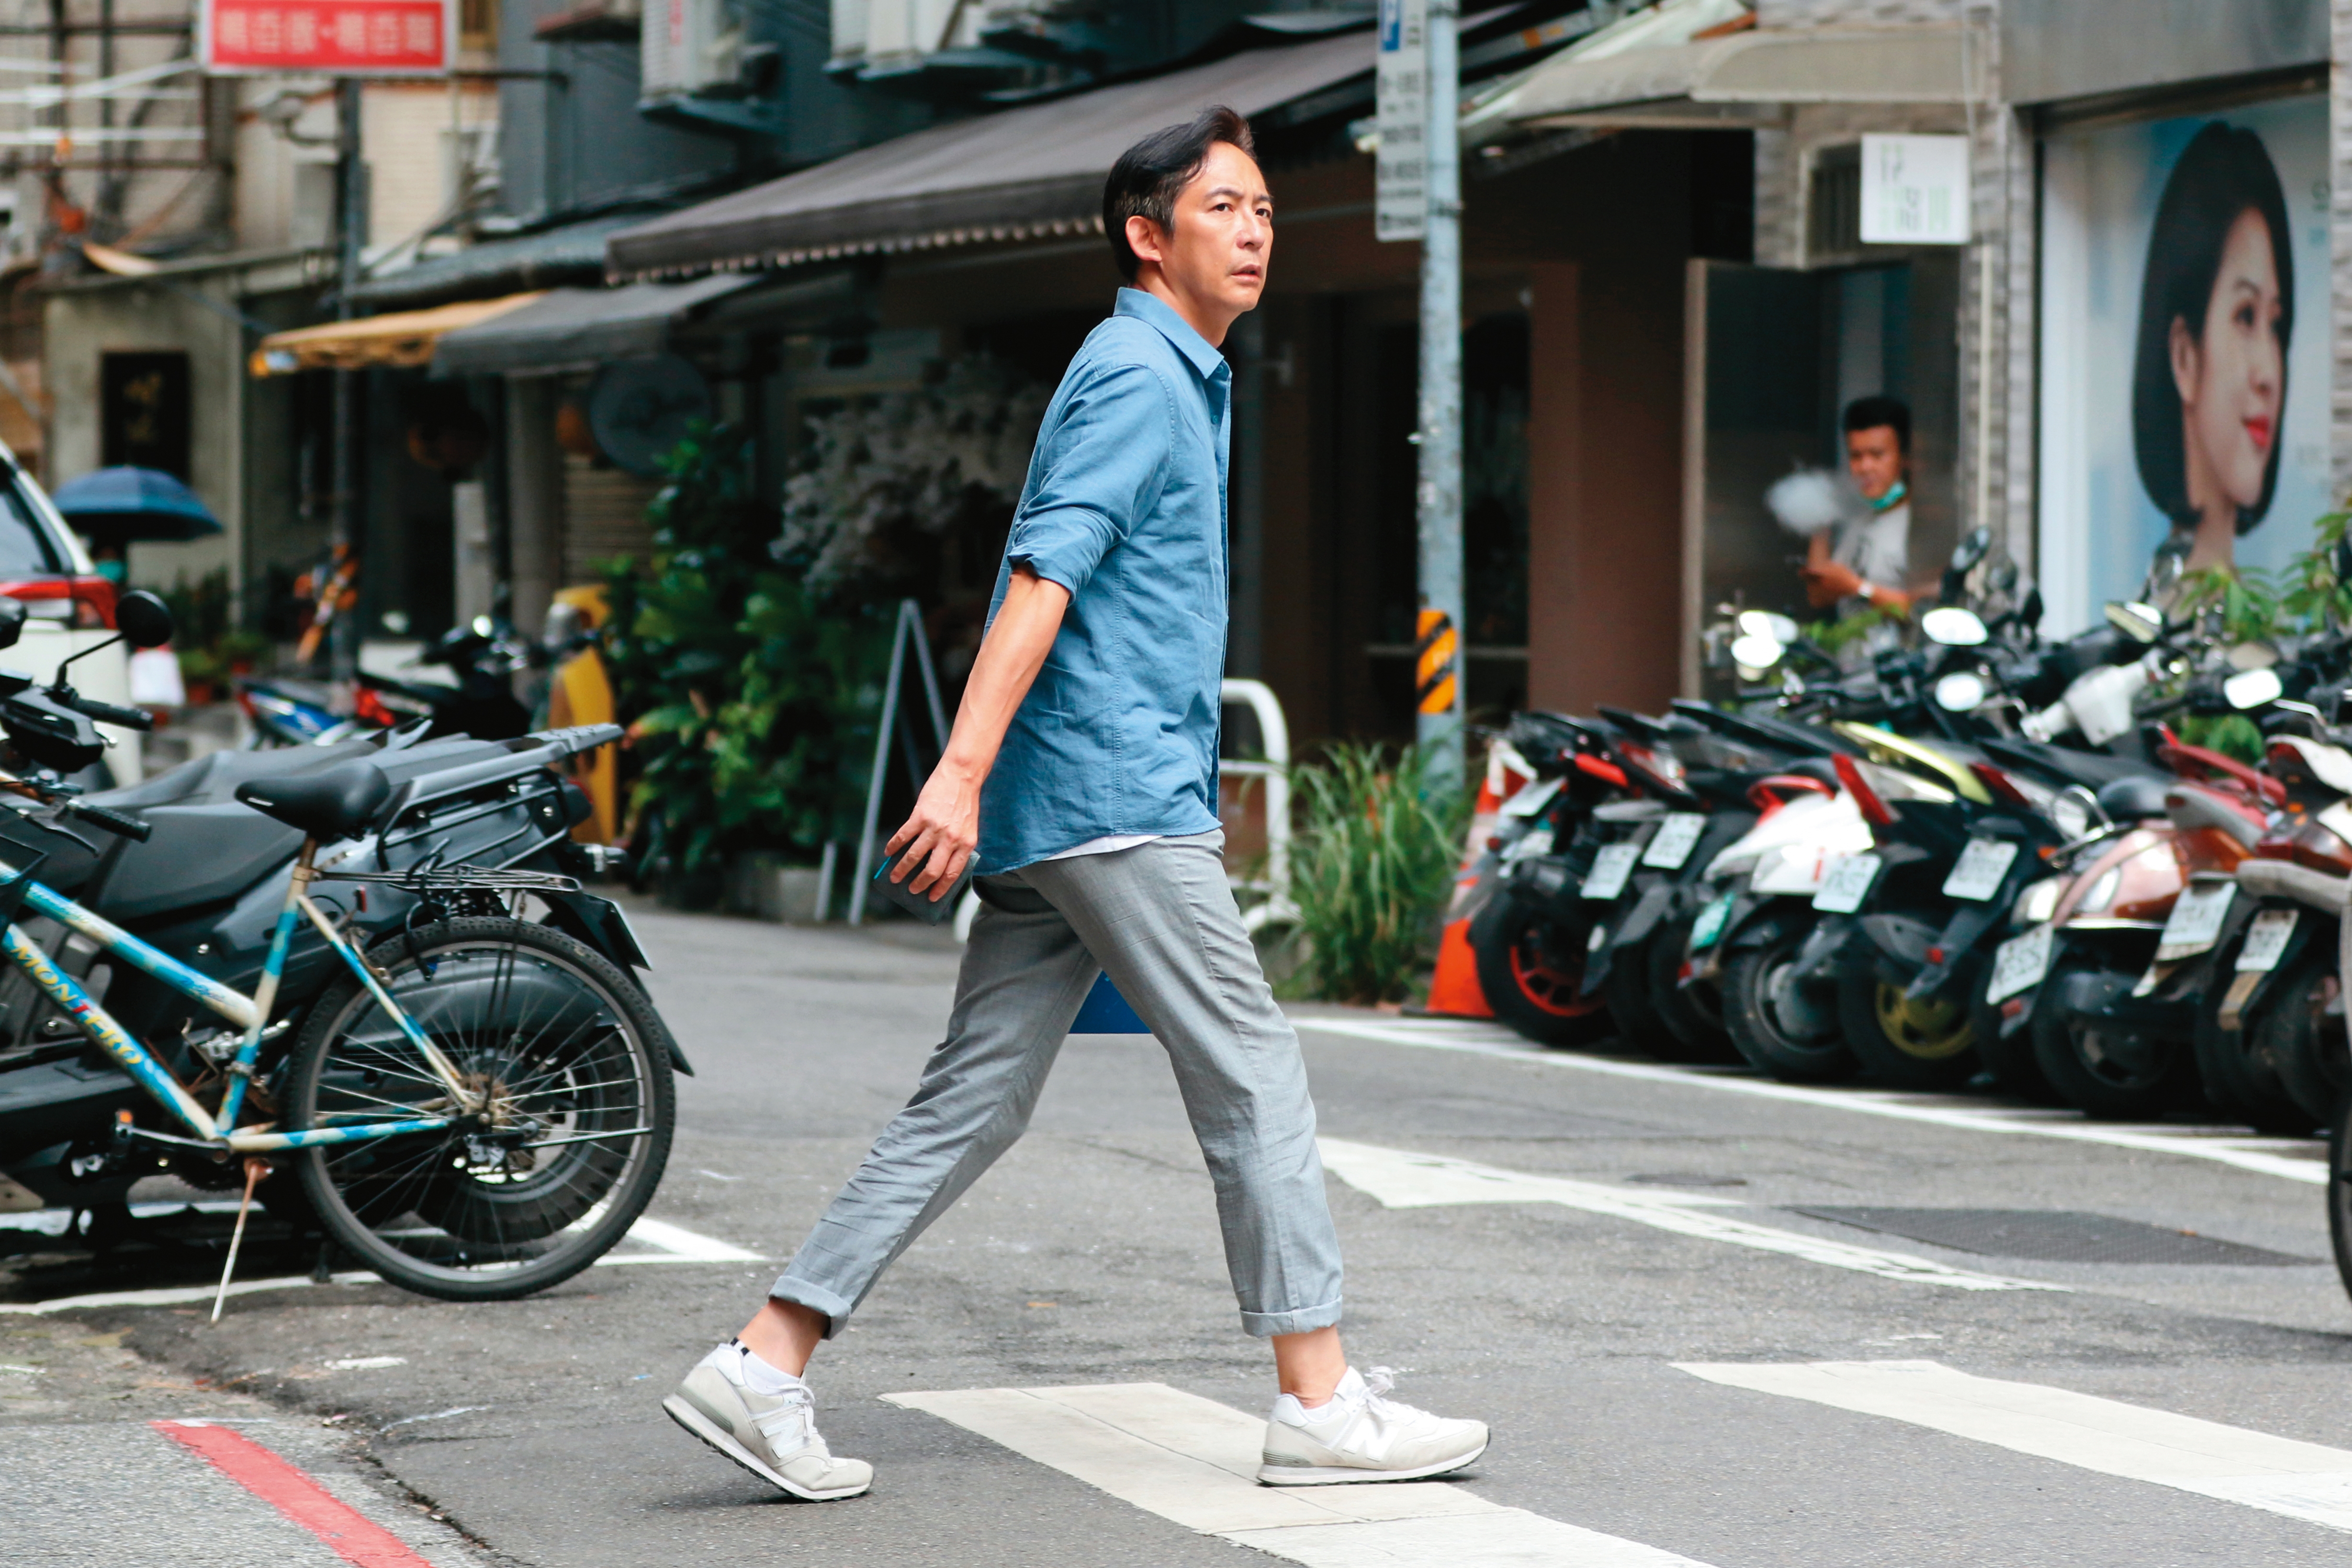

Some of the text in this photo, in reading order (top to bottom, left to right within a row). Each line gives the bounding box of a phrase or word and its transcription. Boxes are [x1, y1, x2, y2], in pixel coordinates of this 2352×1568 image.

[11, 945, 143, 1065] MONTERO
[760, 1416, 812, 1459] N
[1342, 1417, 1400, 1462] N
